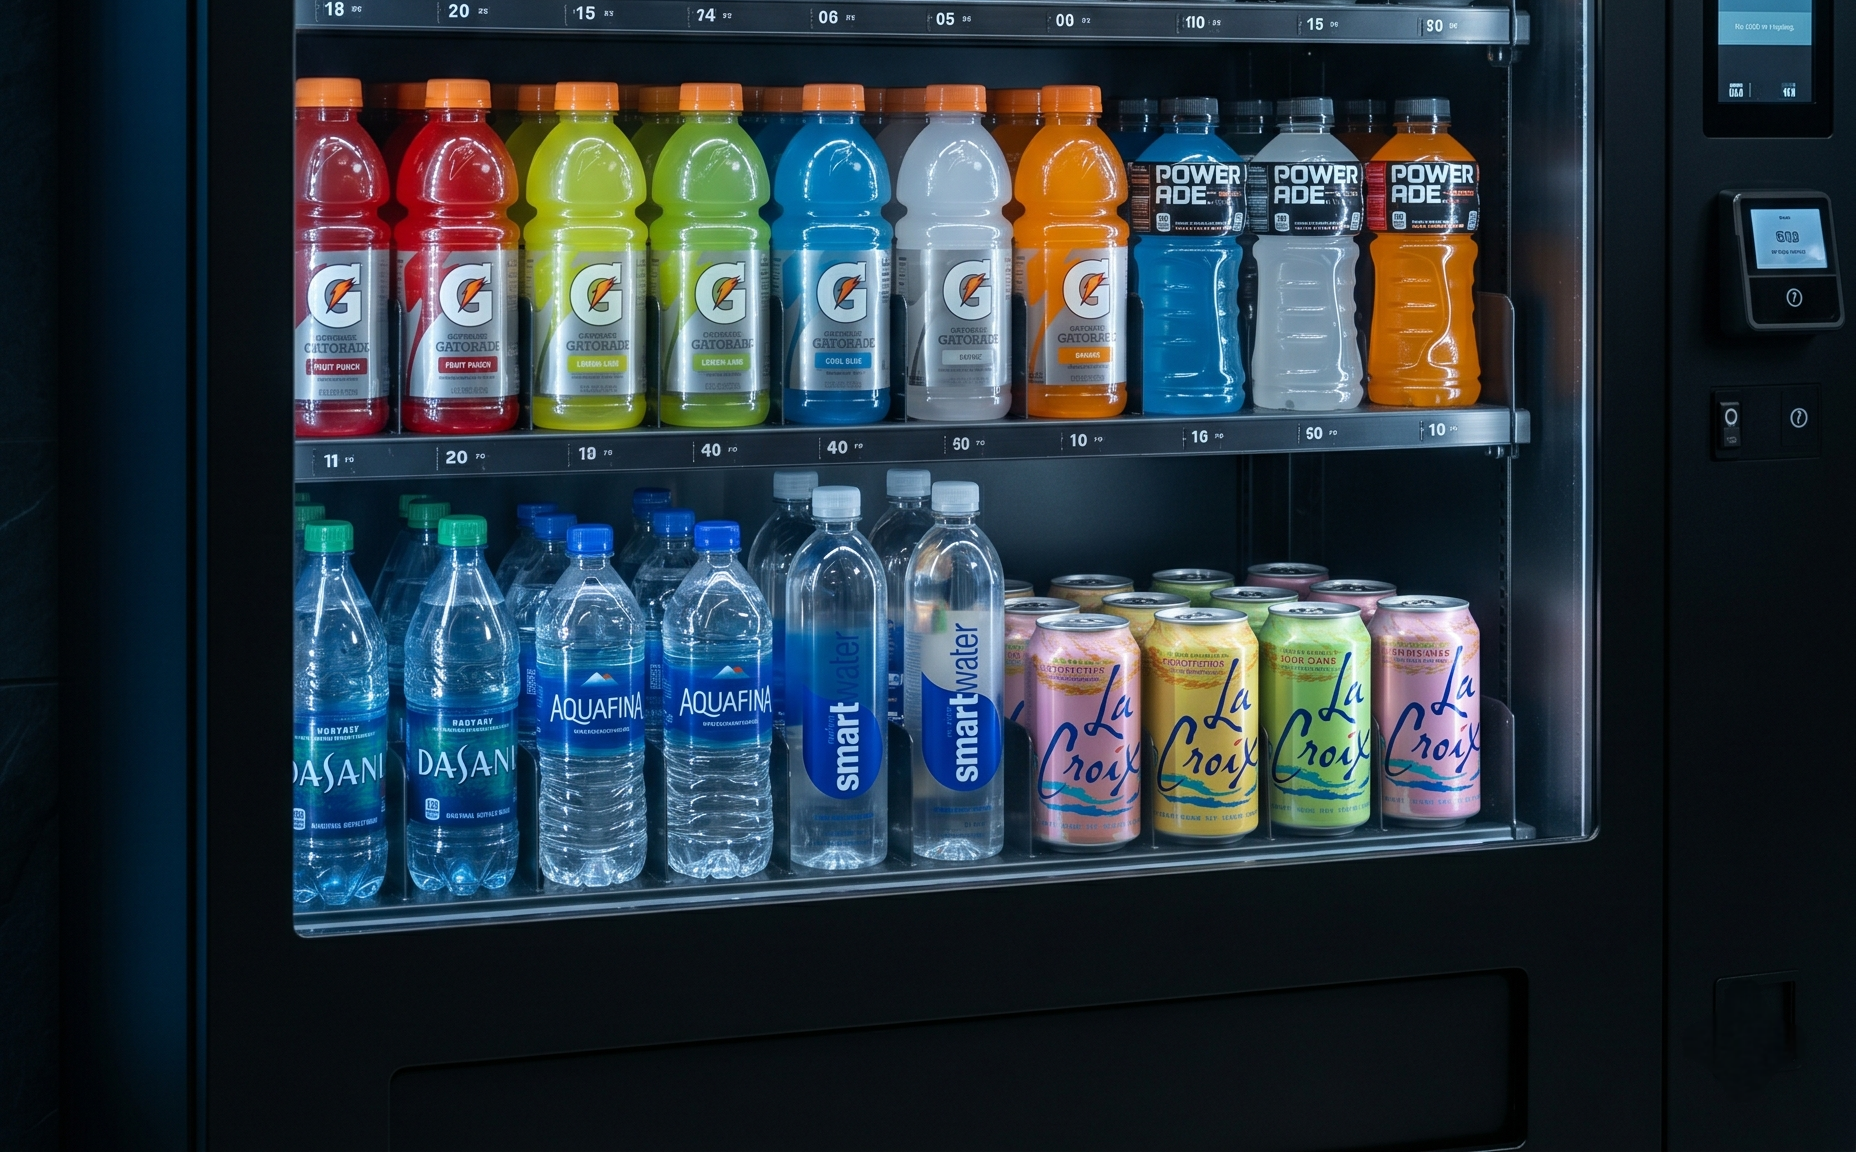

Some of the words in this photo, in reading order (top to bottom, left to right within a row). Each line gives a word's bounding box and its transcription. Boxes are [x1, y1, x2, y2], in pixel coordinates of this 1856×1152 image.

[324, 1, 345, 17] 18
[448, 3, 470, 18] 20
[576, 5, 596, 20] 15
[818, 10, 839, 24] 06
[936, 12, 955, 26] 05
[1306, 17, 1324, 31] 15
[1155, 164, 1240, 184] POWER
[1273, 164, 1358, 184] POWER
[1391, 164, 1474, 184] POWER
[1155, 185, 1207, 204] ADE
[1273, 185, 1325, 204] ADE
[1391, 185, 1441, 203] ADE
[306, 262, 363, 328] G
[439, 262, 494, 327] G
[569, 261, 624, 326] G
[694, 261, 747, 325] G
[816, 260, 868, 323] G
[942, 259, 992, 321] G
[1062, 258, 1111, 320] G
[1070, 433, 1088, 447] 10
[1428, 422, 1446, 437] 10
[323, 453, 338, 468] 11
[445, 450, 468, 465] 20
[700, 442, 722, 458] 40
[826, 440, 848, 455] 40
[1318, 651, 1364, 724] La
[1430, 645, 1475, 718] La
[550, 691, 644, 725] AQUAFINA
[679, 685, 772, 718] AQUAFINA
[1083, 664, 1134, 740] La
[1203, 658, 1252, 732] La
[1271, 708, 1370, 784] Croix
[1384, 702, 1480, 777] Croix
[418, 744, 516, 784] DASANI
[1037, 721, 1140, 799] Croix
[1156, 715, 1258, 792] Croix
